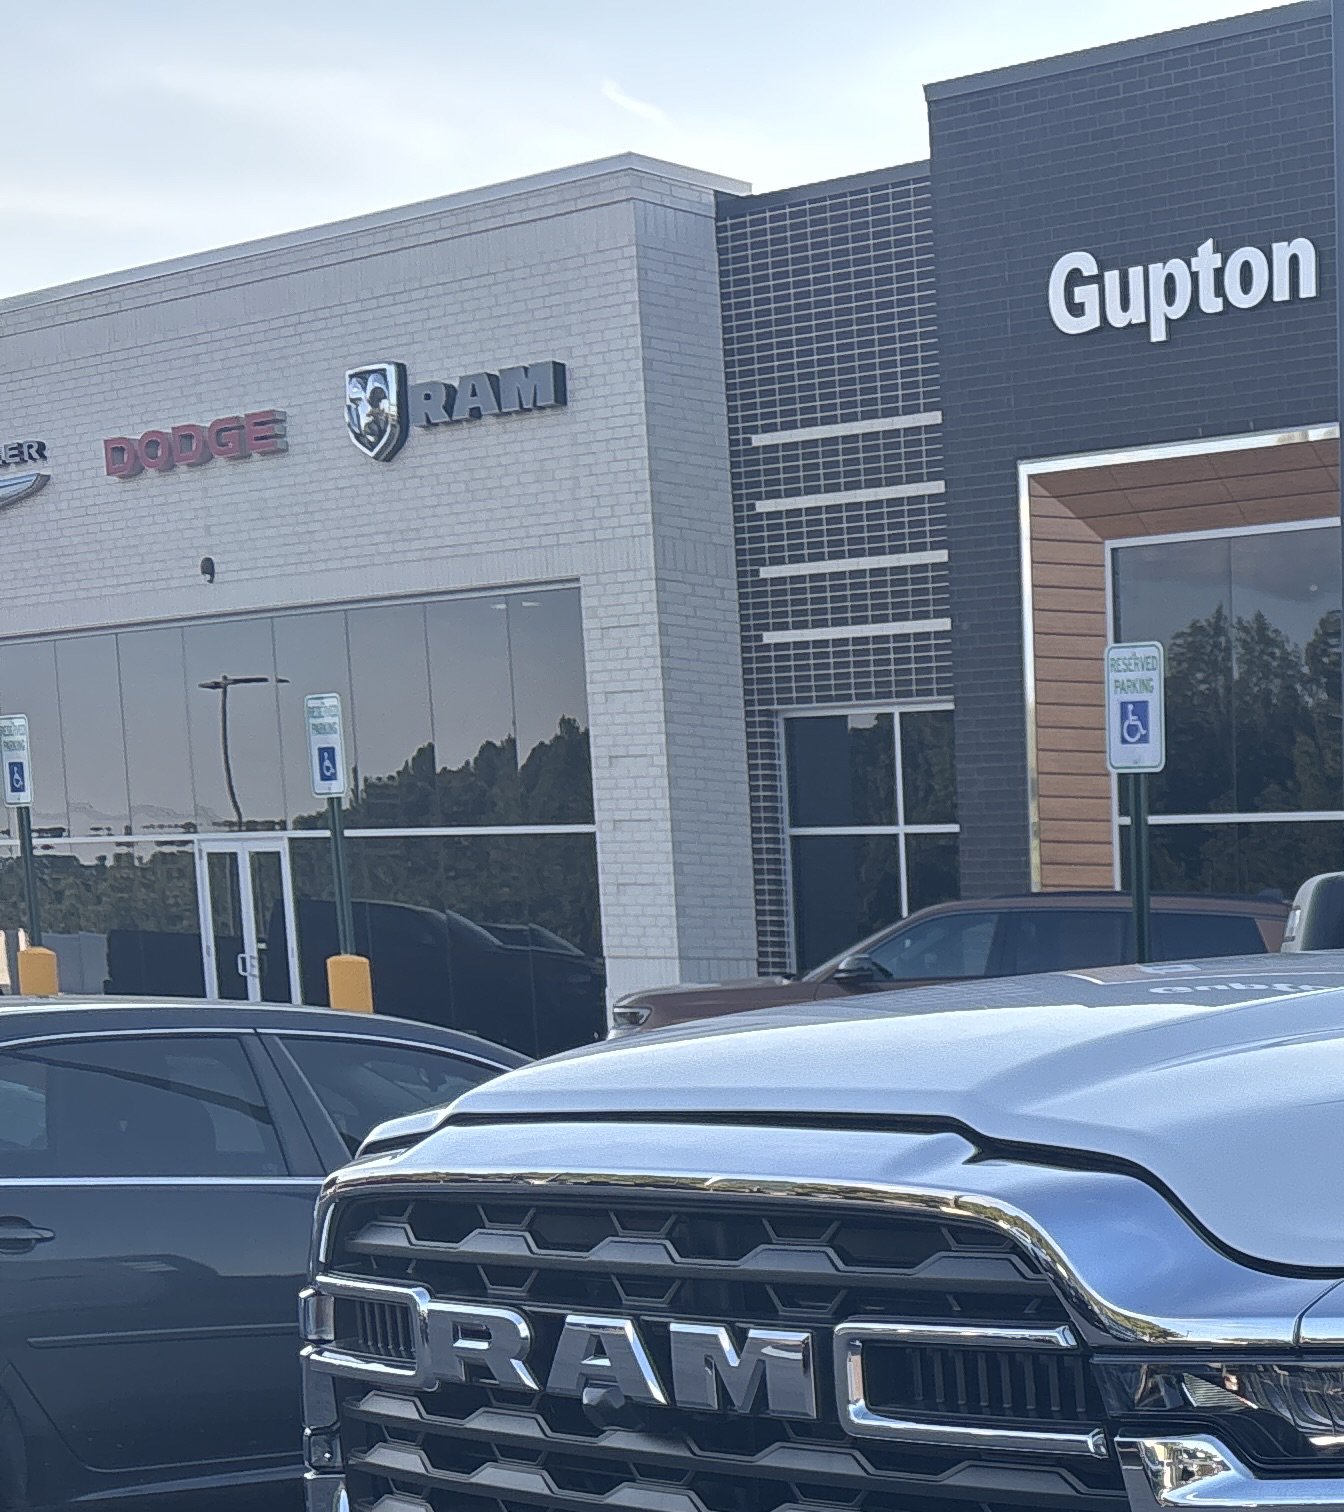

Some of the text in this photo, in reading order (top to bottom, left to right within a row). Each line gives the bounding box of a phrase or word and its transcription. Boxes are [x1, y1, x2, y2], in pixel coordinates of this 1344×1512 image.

[1048, 236, 1319, 344] Gupton
[410, 360, 567, 428] RAM
[0, 440, 48, 466] ER
[103, 410, 288, 479] DODGE
[1110, 655, 1158, 672] RESERVED
[1114, 677, 1154, 694] PARKING
[425, 1299, 818, 1421] RAM
